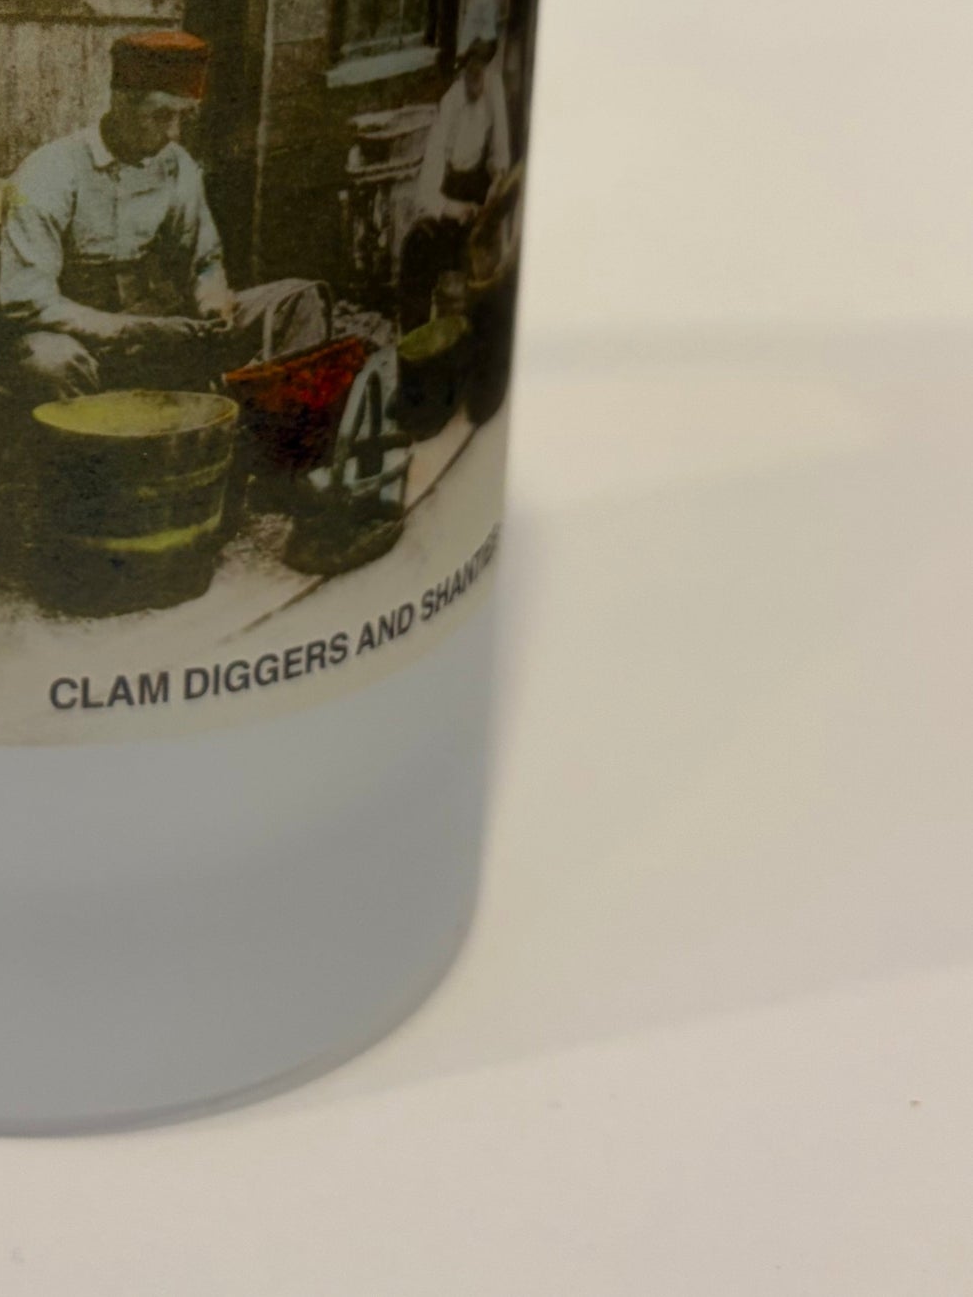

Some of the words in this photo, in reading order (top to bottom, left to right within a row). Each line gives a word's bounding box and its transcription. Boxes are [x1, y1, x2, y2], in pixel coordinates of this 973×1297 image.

[49, 671, 169, 710] CLAM
[183, 632, 348, 700] DIGGERS
[356, 602, 415, 656] AND
